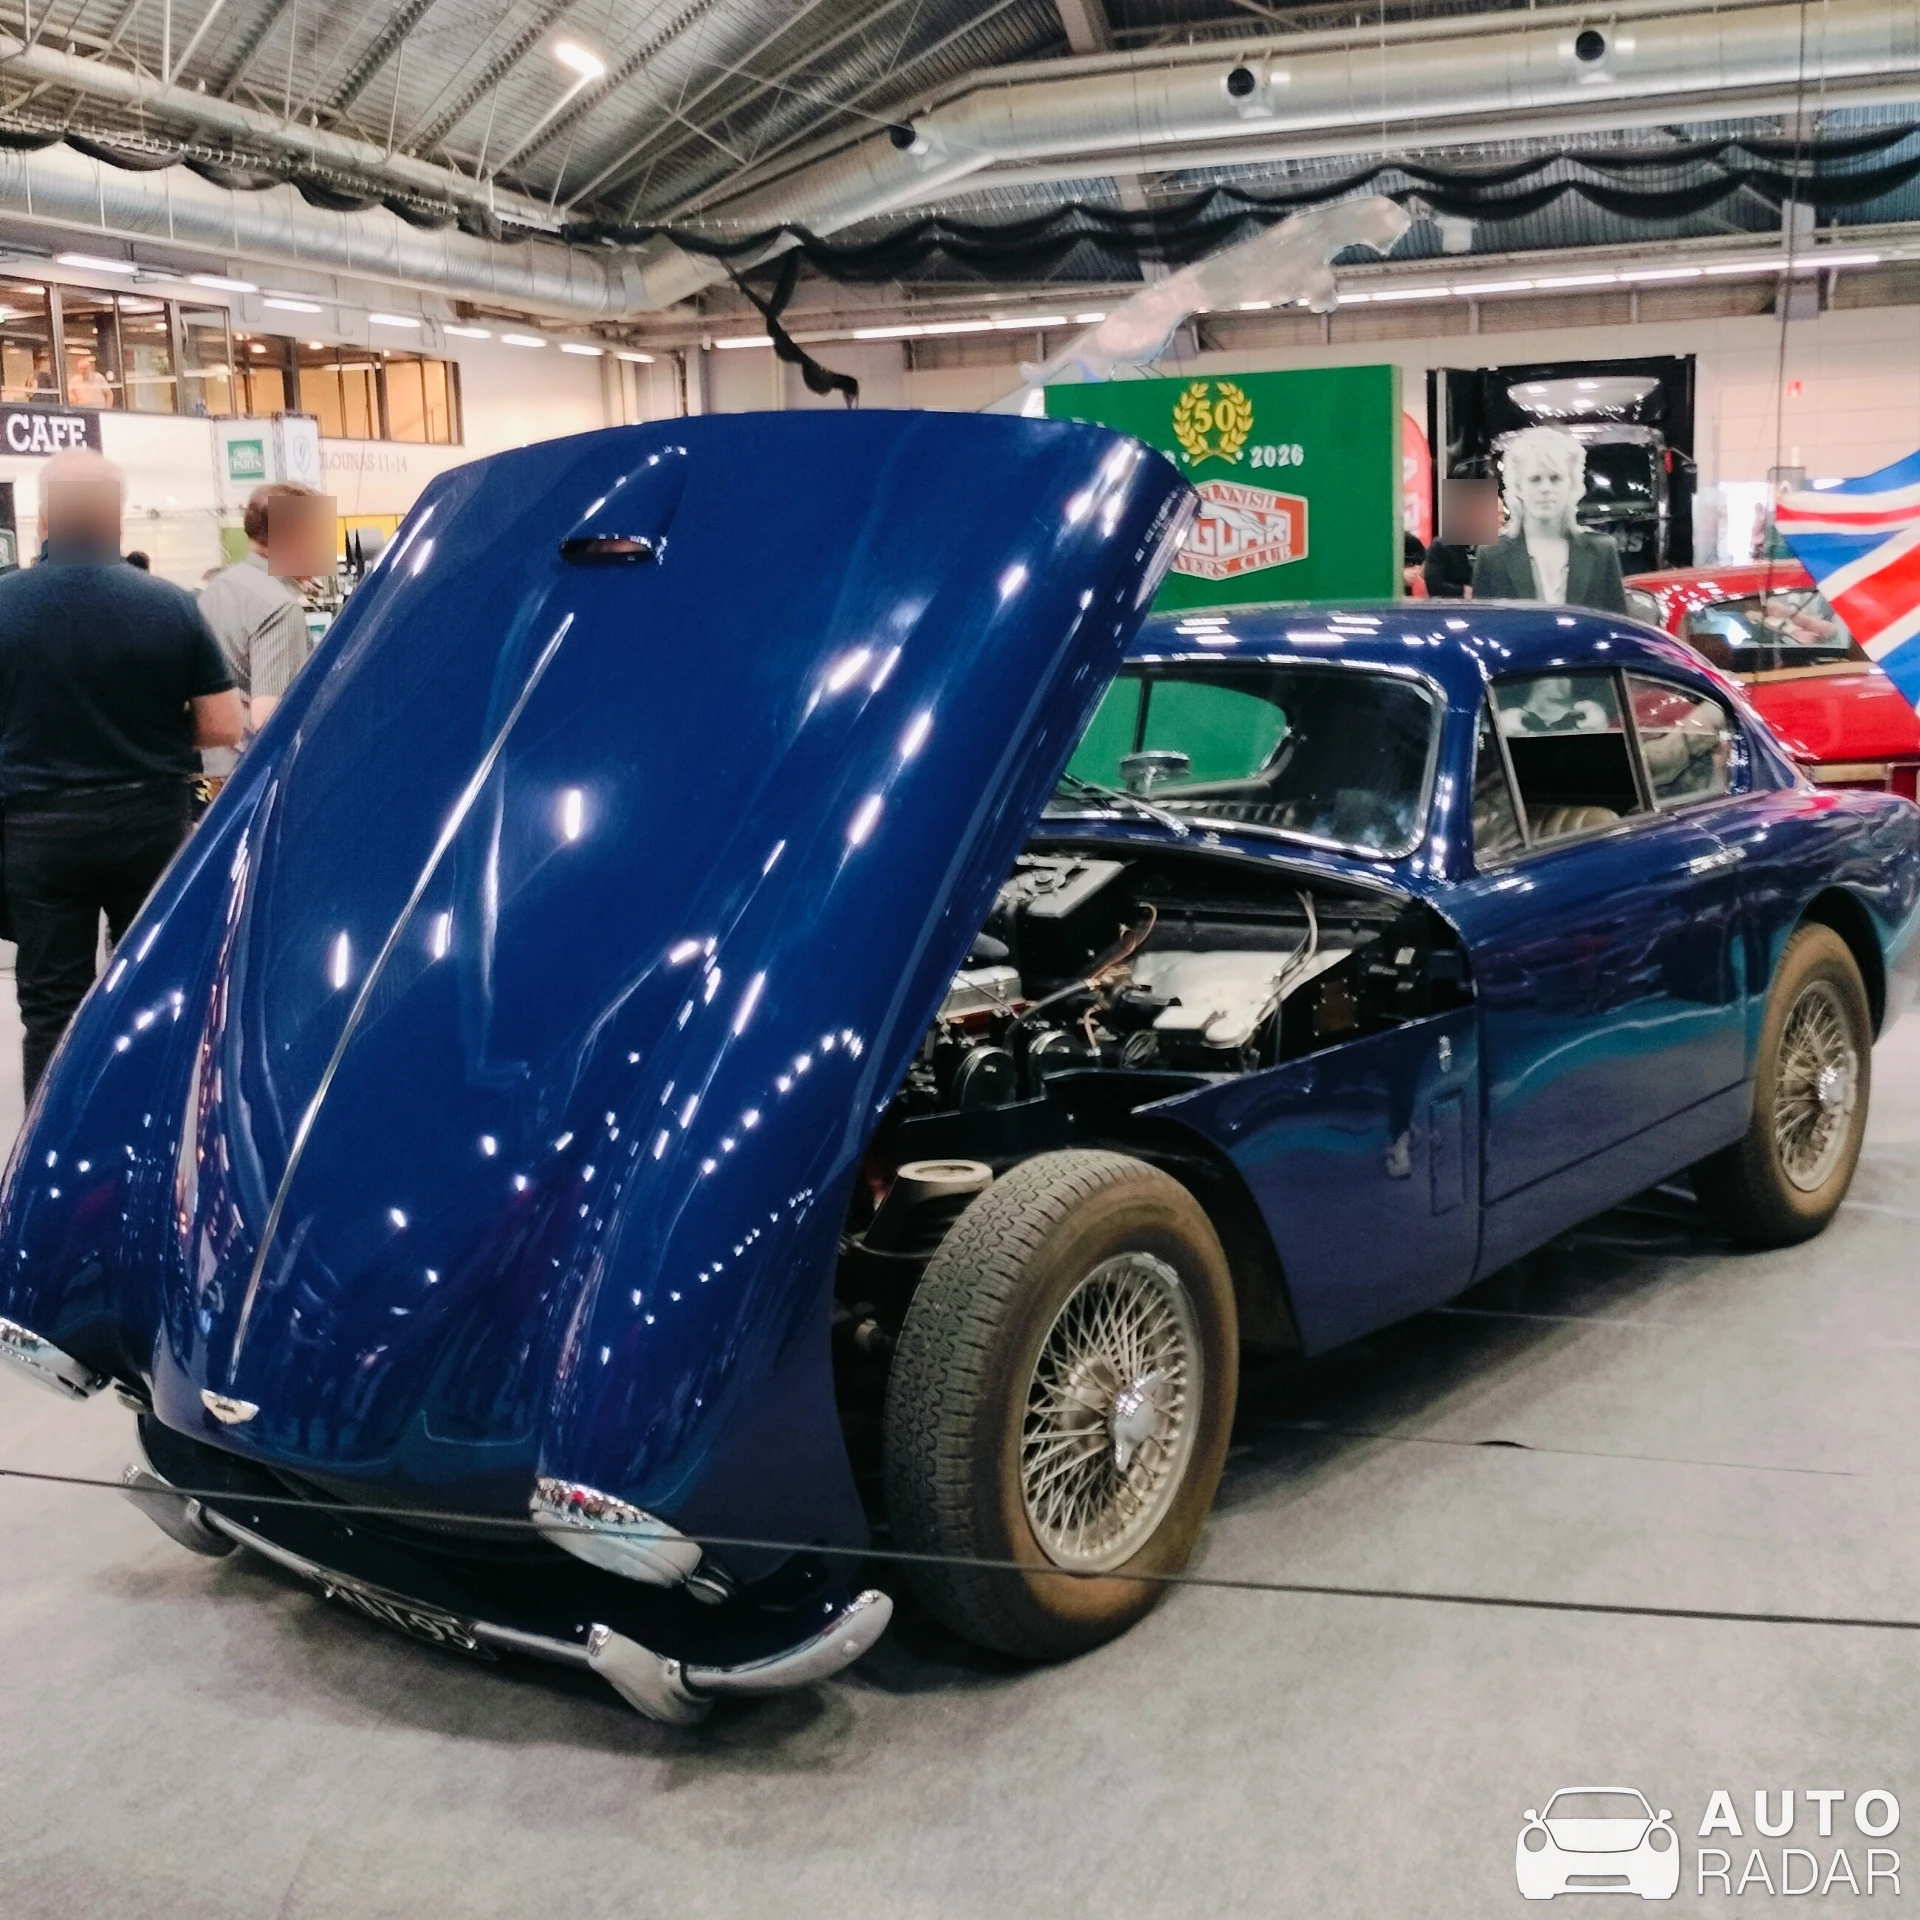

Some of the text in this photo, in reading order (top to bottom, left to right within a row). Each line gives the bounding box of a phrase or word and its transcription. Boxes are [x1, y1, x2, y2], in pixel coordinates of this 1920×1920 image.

[1194, 400, 1236, 433] 50
[7, 412, 88, 453] CAFE
[1251, 444, 1304, 468] 2026
[1240, 545, 1291, 569] CLUB
